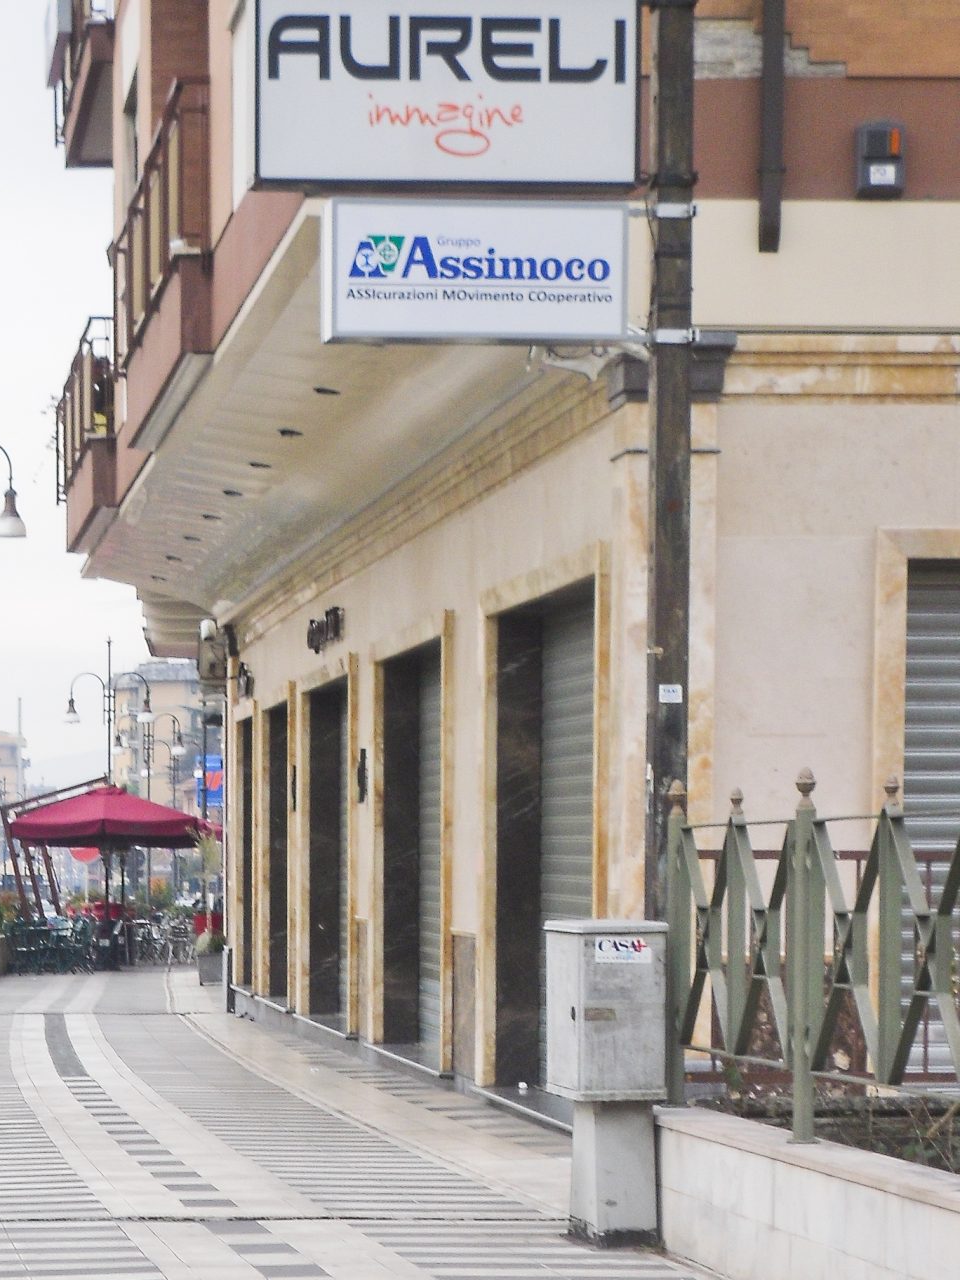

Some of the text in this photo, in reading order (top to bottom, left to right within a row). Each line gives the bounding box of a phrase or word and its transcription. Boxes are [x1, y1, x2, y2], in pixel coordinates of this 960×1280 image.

[268, 14, 626, 84] AURELI
[368, 92, 524, 157] immagine
[401, 235, 611, 282] Assimoco
[437, 236, 481, 248] Gruppo
[346, 287, 613, 304] ASSIcurazioni MOvimento COoperativo
